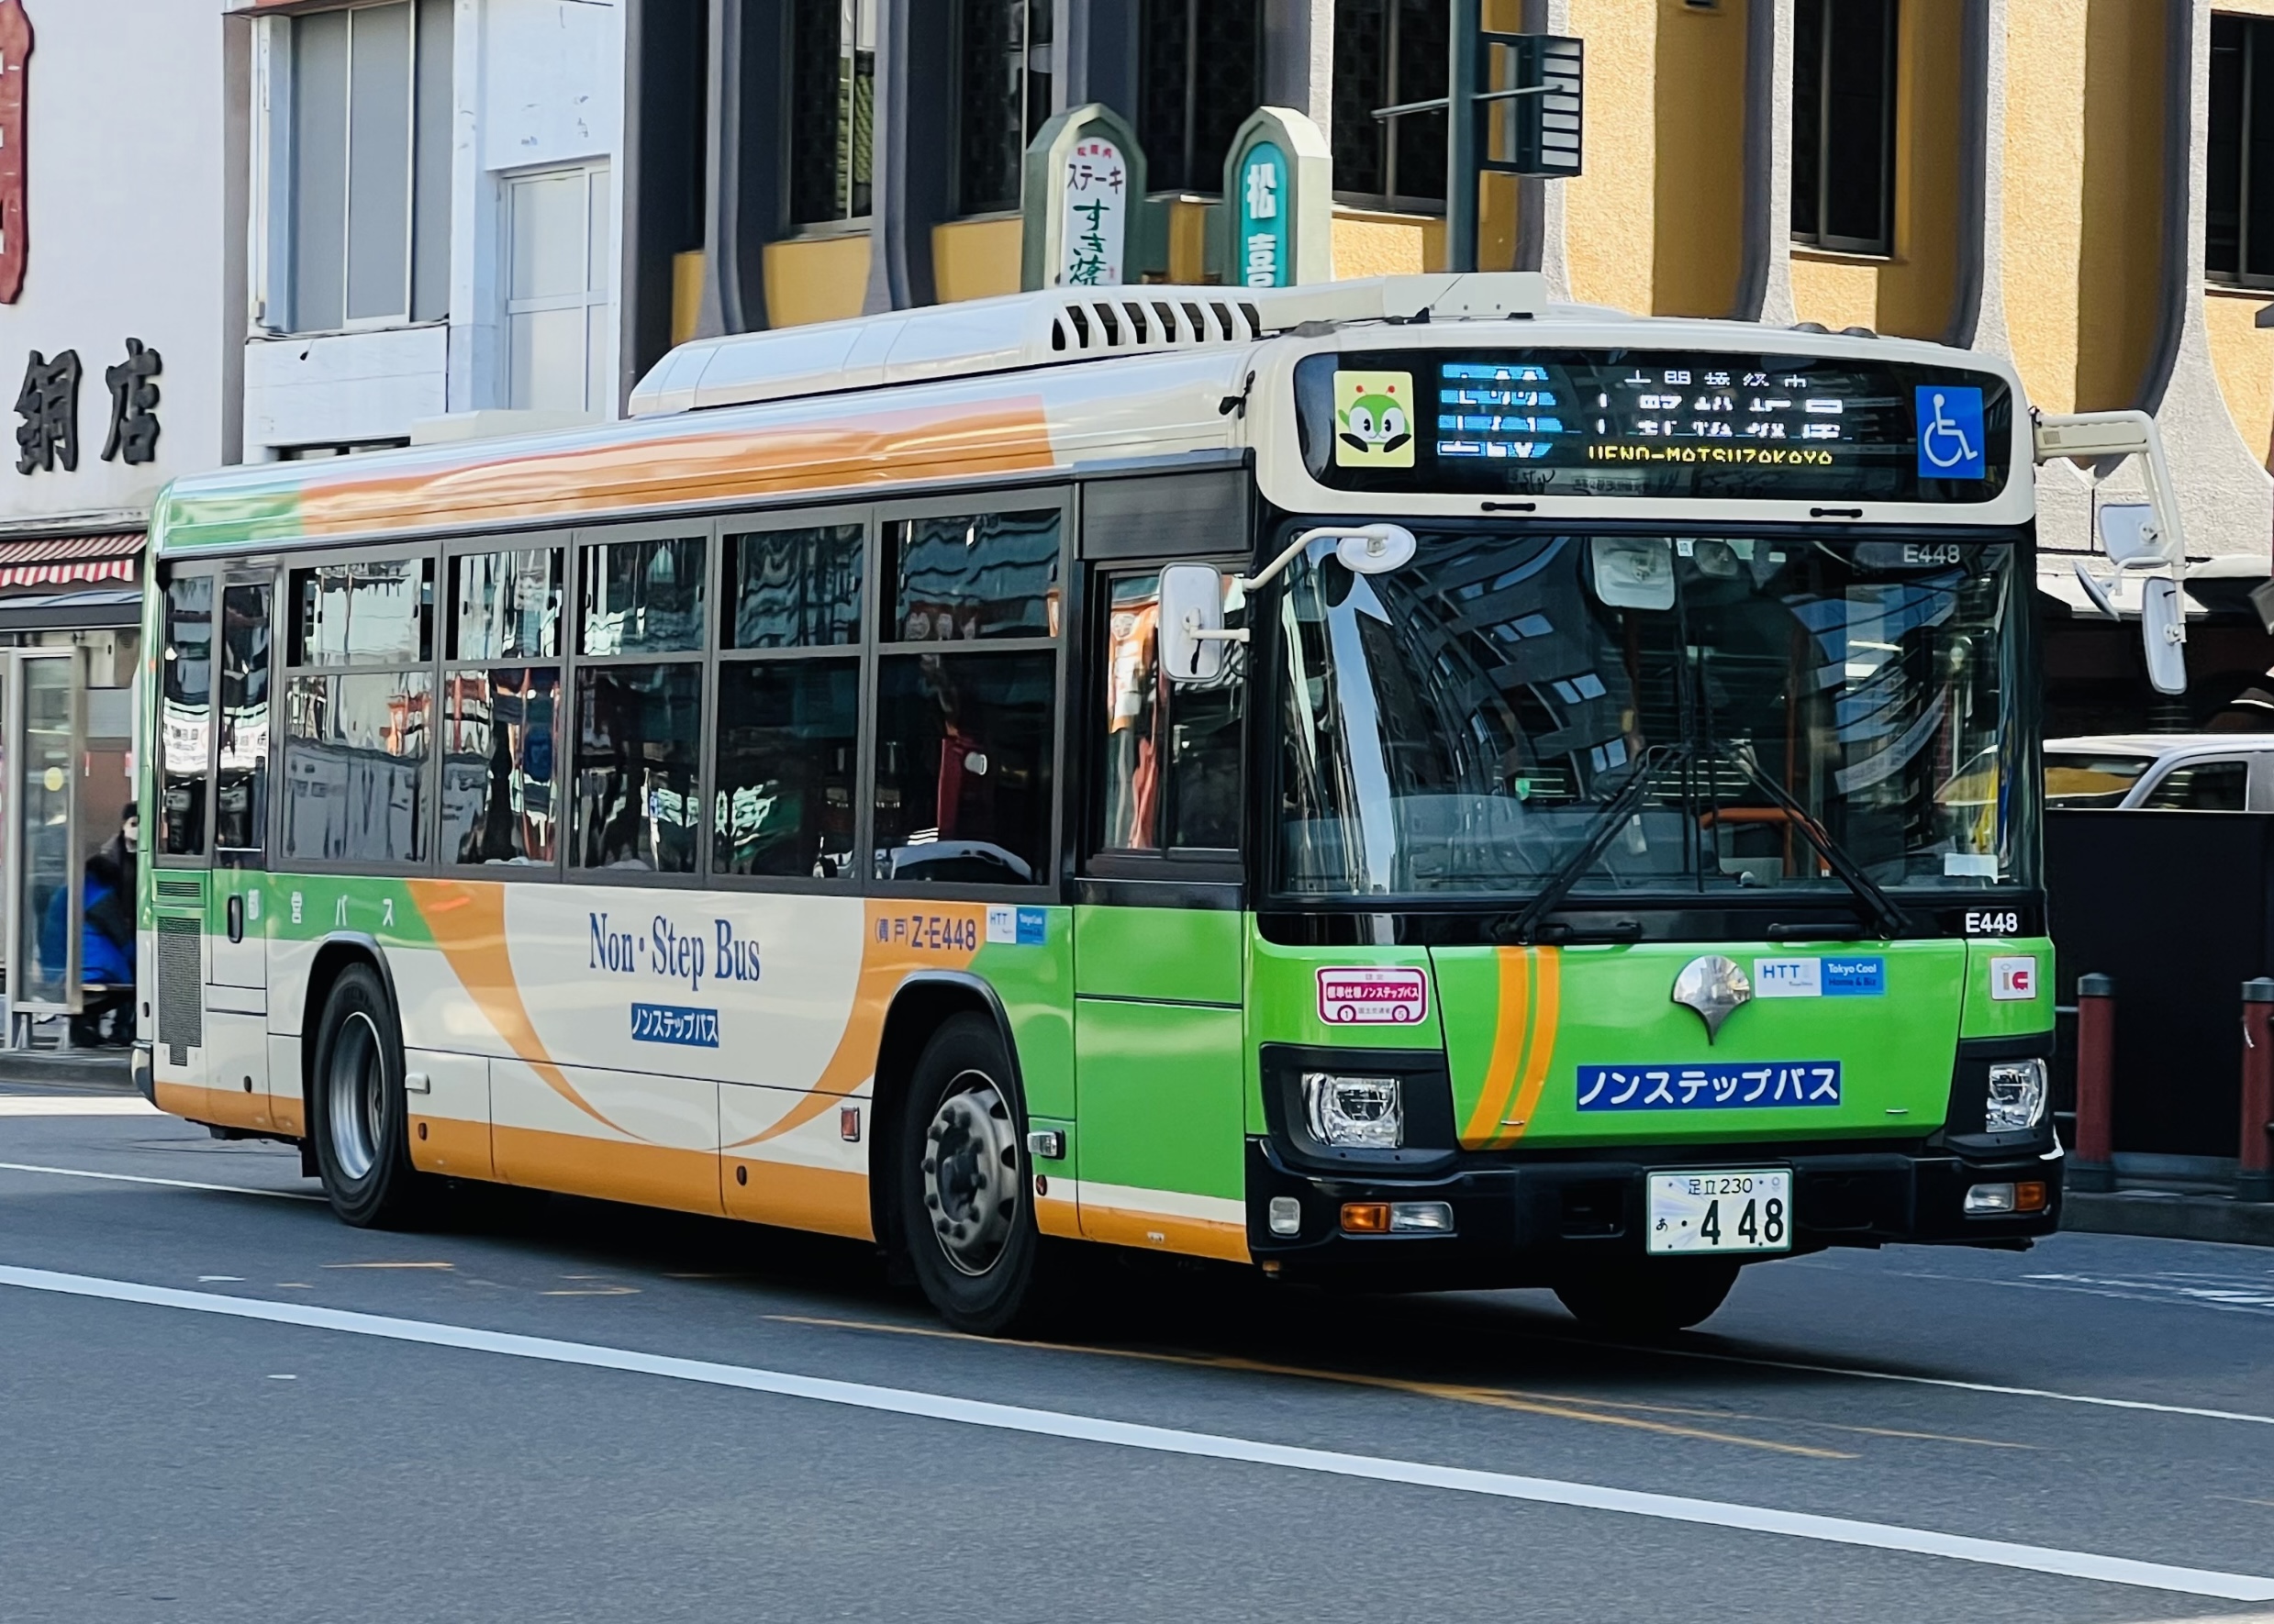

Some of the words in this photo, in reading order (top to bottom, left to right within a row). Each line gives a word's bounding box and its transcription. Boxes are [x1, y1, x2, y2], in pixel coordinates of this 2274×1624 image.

[1066, 163, 1124, 195] ステーキ
[1903, 543, 1961, 564] E448
[1965, 912, 2018, 933] E448
[714, 918, 761, 982] Bus
[1827, 963, 1856, 976] Tokyo
[1856, 963, 1878, 973] Cool
[631, 1008, 719, 1042] ノンステップバス
[1578, 1068, 1838, 1106] ノンステップバス
[1655, 1218, 1668, 1232] あ
